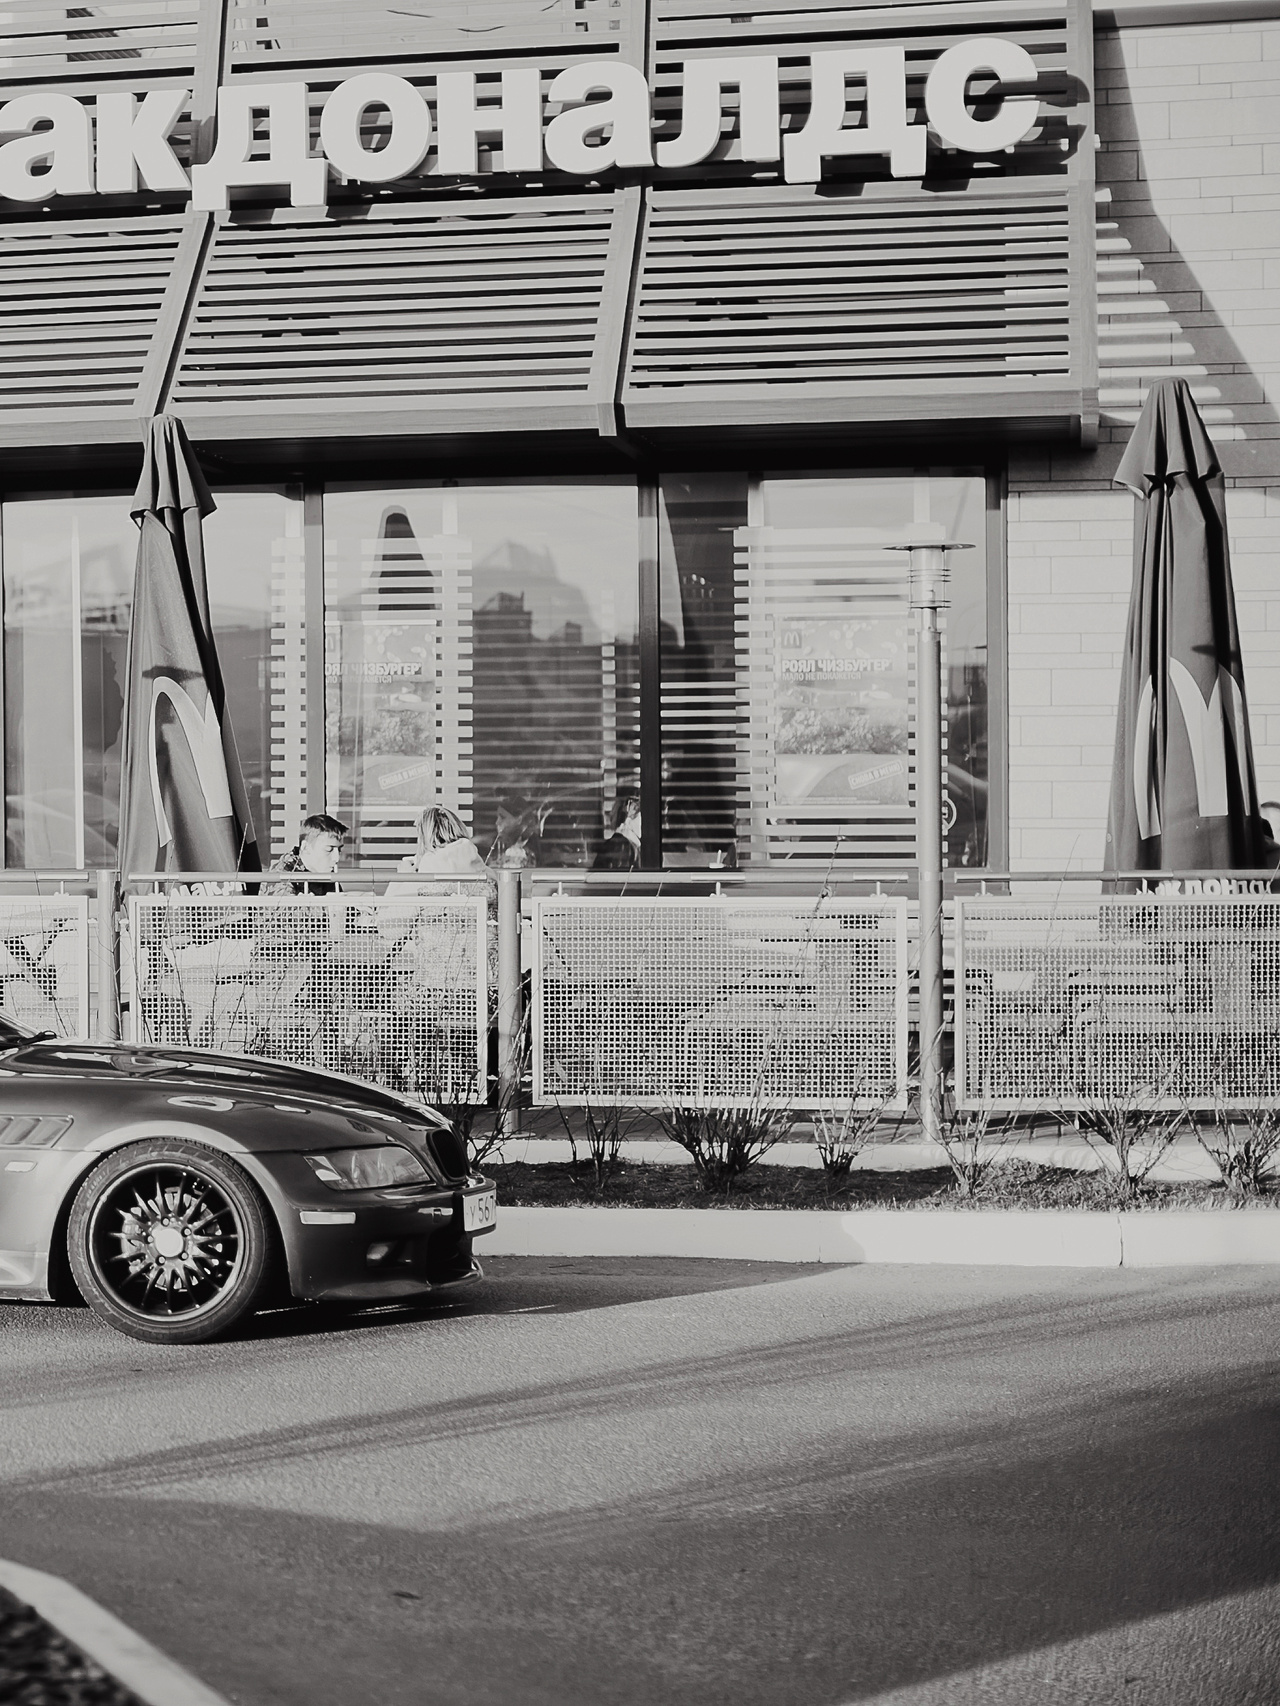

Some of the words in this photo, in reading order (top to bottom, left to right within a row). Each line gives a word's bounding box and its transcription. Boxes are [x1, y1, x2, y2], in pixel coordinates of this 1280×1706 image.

[782, 659, 816, 672] РОЯЛ
[817, 658, 891, 672] ЧИЗБУРГЕР
[782, 672, 805, 681] МАЛО
[805, 672, 815, 681] НЕ
[816, 671, 862, 681] ПОКАЖЕТСЯ
